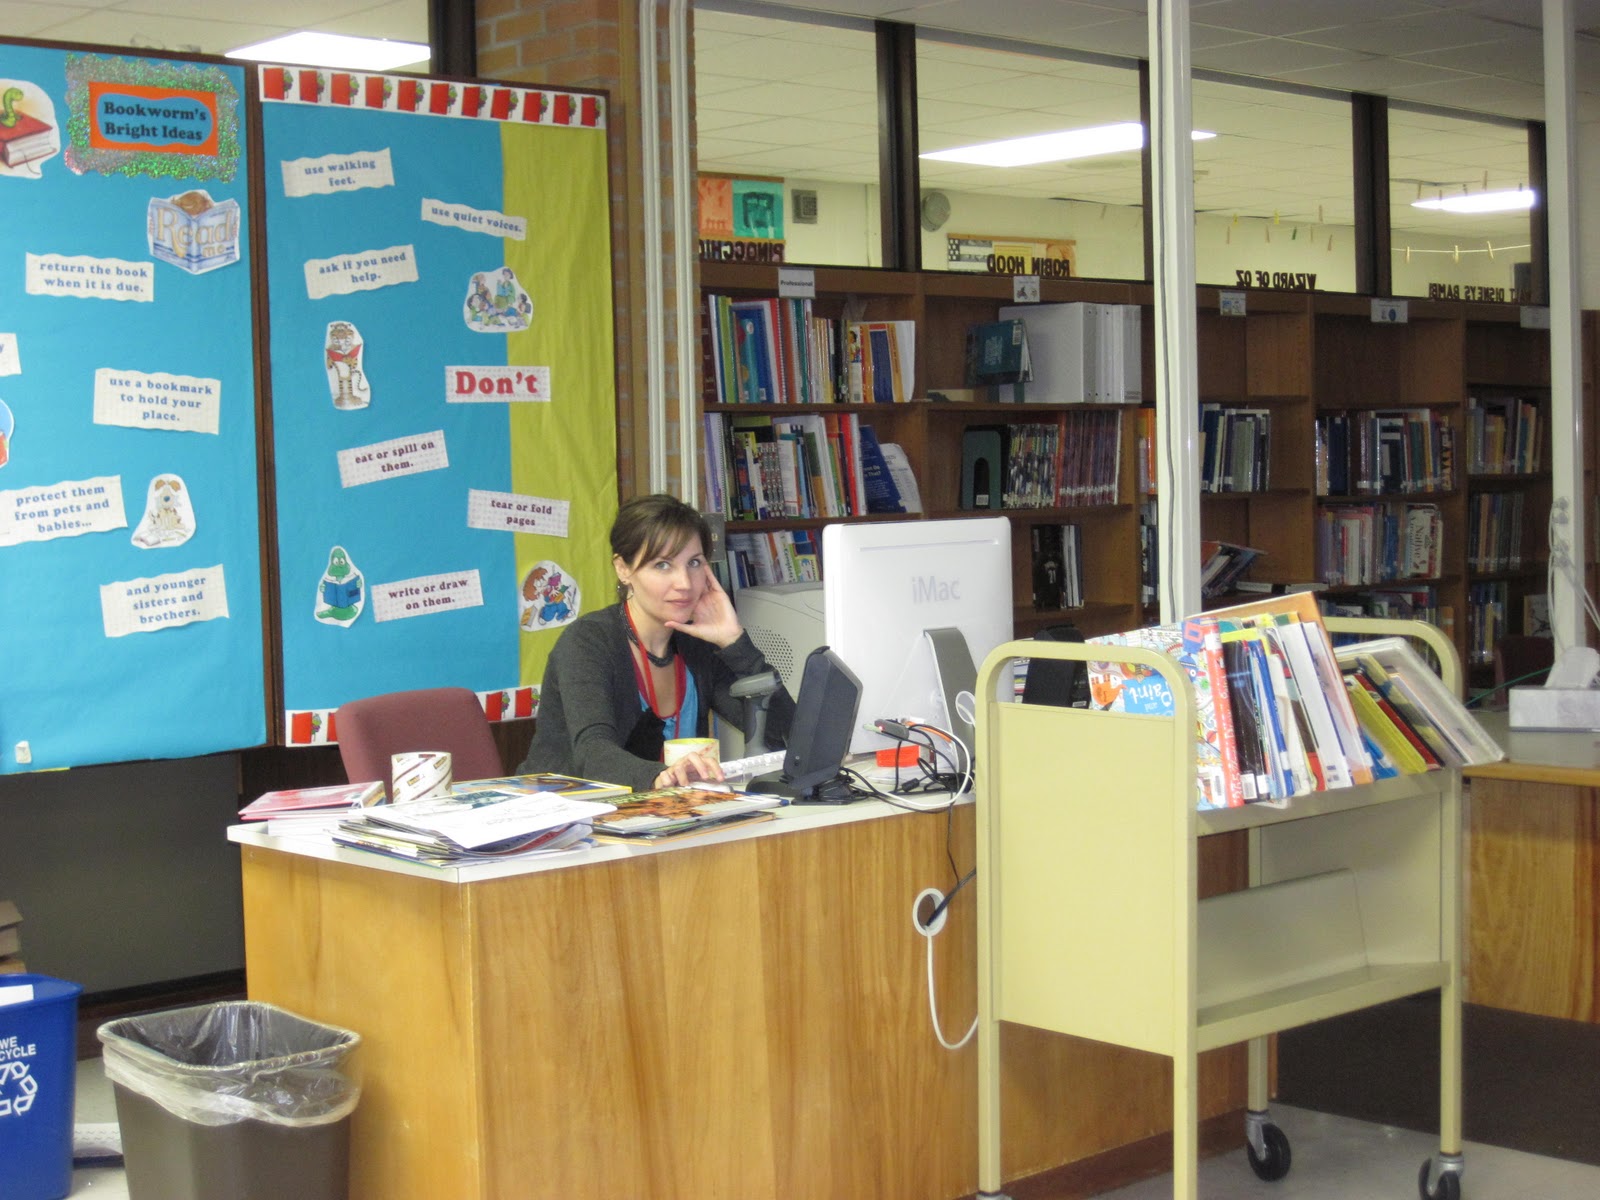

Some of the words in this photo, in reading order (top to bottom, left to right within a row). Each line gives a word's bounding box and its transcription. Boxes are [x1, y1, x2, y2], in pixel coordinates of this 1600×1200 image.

[103, 102, 207, 121] Bookworm's
[104, 122, 158, 139] Bright
[162, 123, 203, 141] Ideas
[304, 164, 324, 175] use
[328, 159, 376, 174] walking
[328, 175, 356, 187] feet.
[431, 205, 450, 217] use
[453, 209, 482, 225] quiet
[486, 217, 522, 233] voices.
[157, 208, 232, 258] Read
[40, 262, 85, 274] return
[90, 264, 111, 275] the
[115, 265, 148, 278] book
[319, 263, 339, 275] ask
[343, 260, 353, 271] if
[356, 258, 378, 271] you
[381, 252, 406, 265] need
[44, 277, 80, 289] when
[85, 279, 97, 290] it
[101, 280, 112, 290] is
[117, 281, 144, 292] due.
[351, 270, 381, 285] help.
[110, 377, 131, 388] use
[135, 380, 143, 388] a
[147, 379, 213, 395] bookmark
[455, 371, 538, 395] Don't
[120, 392, 134, 403] to
[139, 393, 168, 406] hold
[172, 398, 202, 411] your
[142, 409, 180, 422] place.
[355, 453, 374, 465] eat
[377, 450, 389, 460] or
[392, 443, 418, 458] spill
[421, 440, 435, 451] on
[381, 460, 414, 474] them.
[16, 490, 67, 507] protect
[72, 484, 106, 497] them
[14, 508, 49, 522] from
[53, 504, 82, 519] pets
[86, 498, 110, 511] and
[491, 499, 513, 511] tear
[516, 503, 528, 512] or
[531, 502, 553, 515] fold
[37, 521, 92, 534] babies...
[506, 514, 535, 527] pages
[126, 584, 150, 597] and
[154, 576, 207, 594] younger
[388, 587, 420, 600] write
[424, 583, 436, 593] or
[439, 578, 468, 591] draw
[911, 575, 961, 605] iMac
[133, 596, 178, 611] sisters
[181, 591, 204, 604] and
[405, 601, 419, 611] on
[422, 596, 455, 609] them.
[139, 609, 201, 625] brothers.
